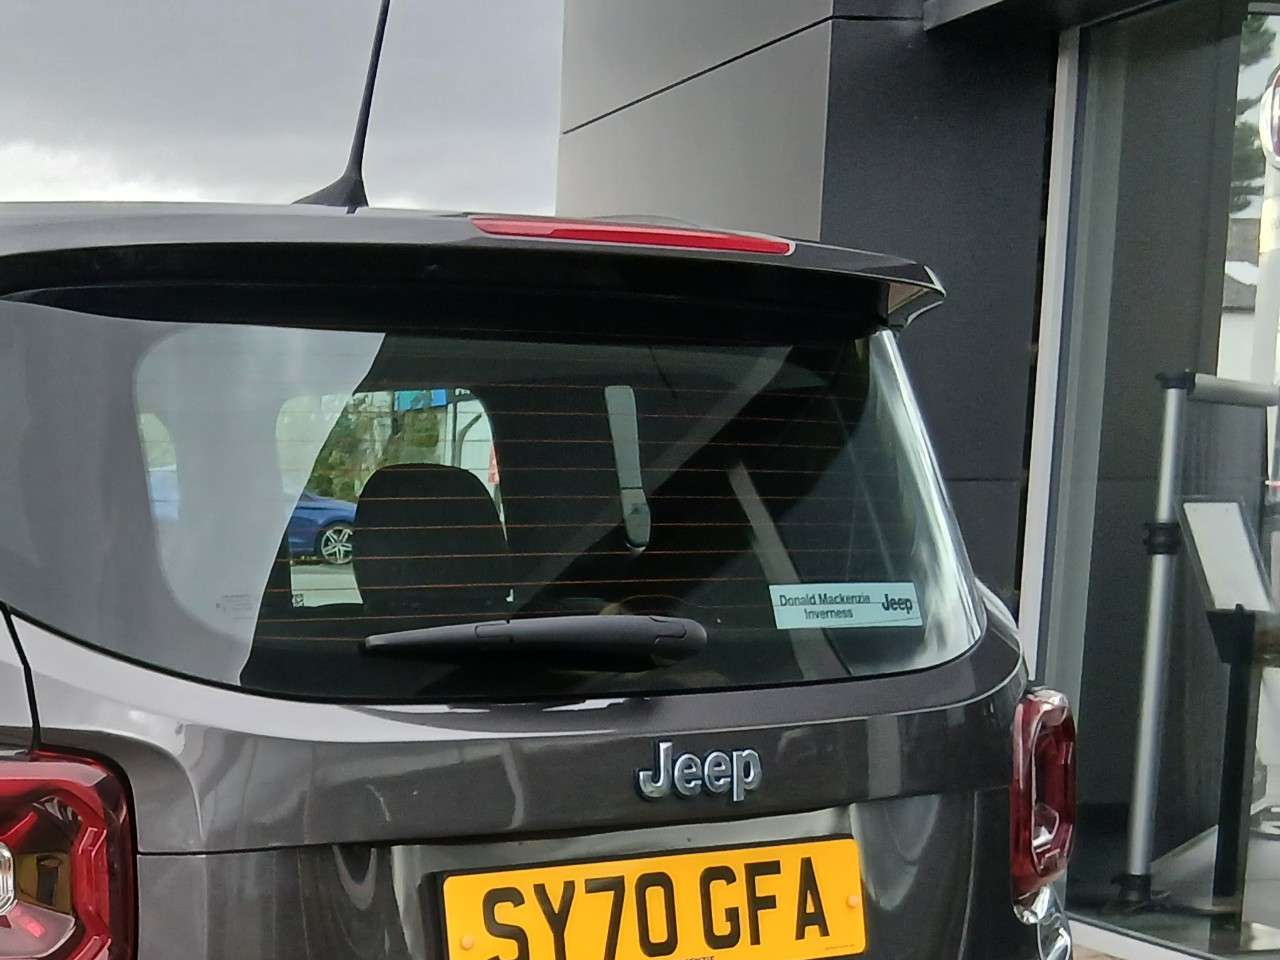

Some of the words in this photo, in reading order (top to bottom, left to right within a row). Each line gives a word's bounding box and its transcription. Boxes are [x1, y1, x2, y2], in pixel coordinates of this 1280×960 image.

[780, 593, 816, 607] Donald
[818, 592, 870, 605] Mackenzie
[881, 593, 913, 614] Jeep
[804, 608, 854, 620] Inverness
[636, 741, 763, 802] Jeep
[699, 856, 830, 950] GFA
